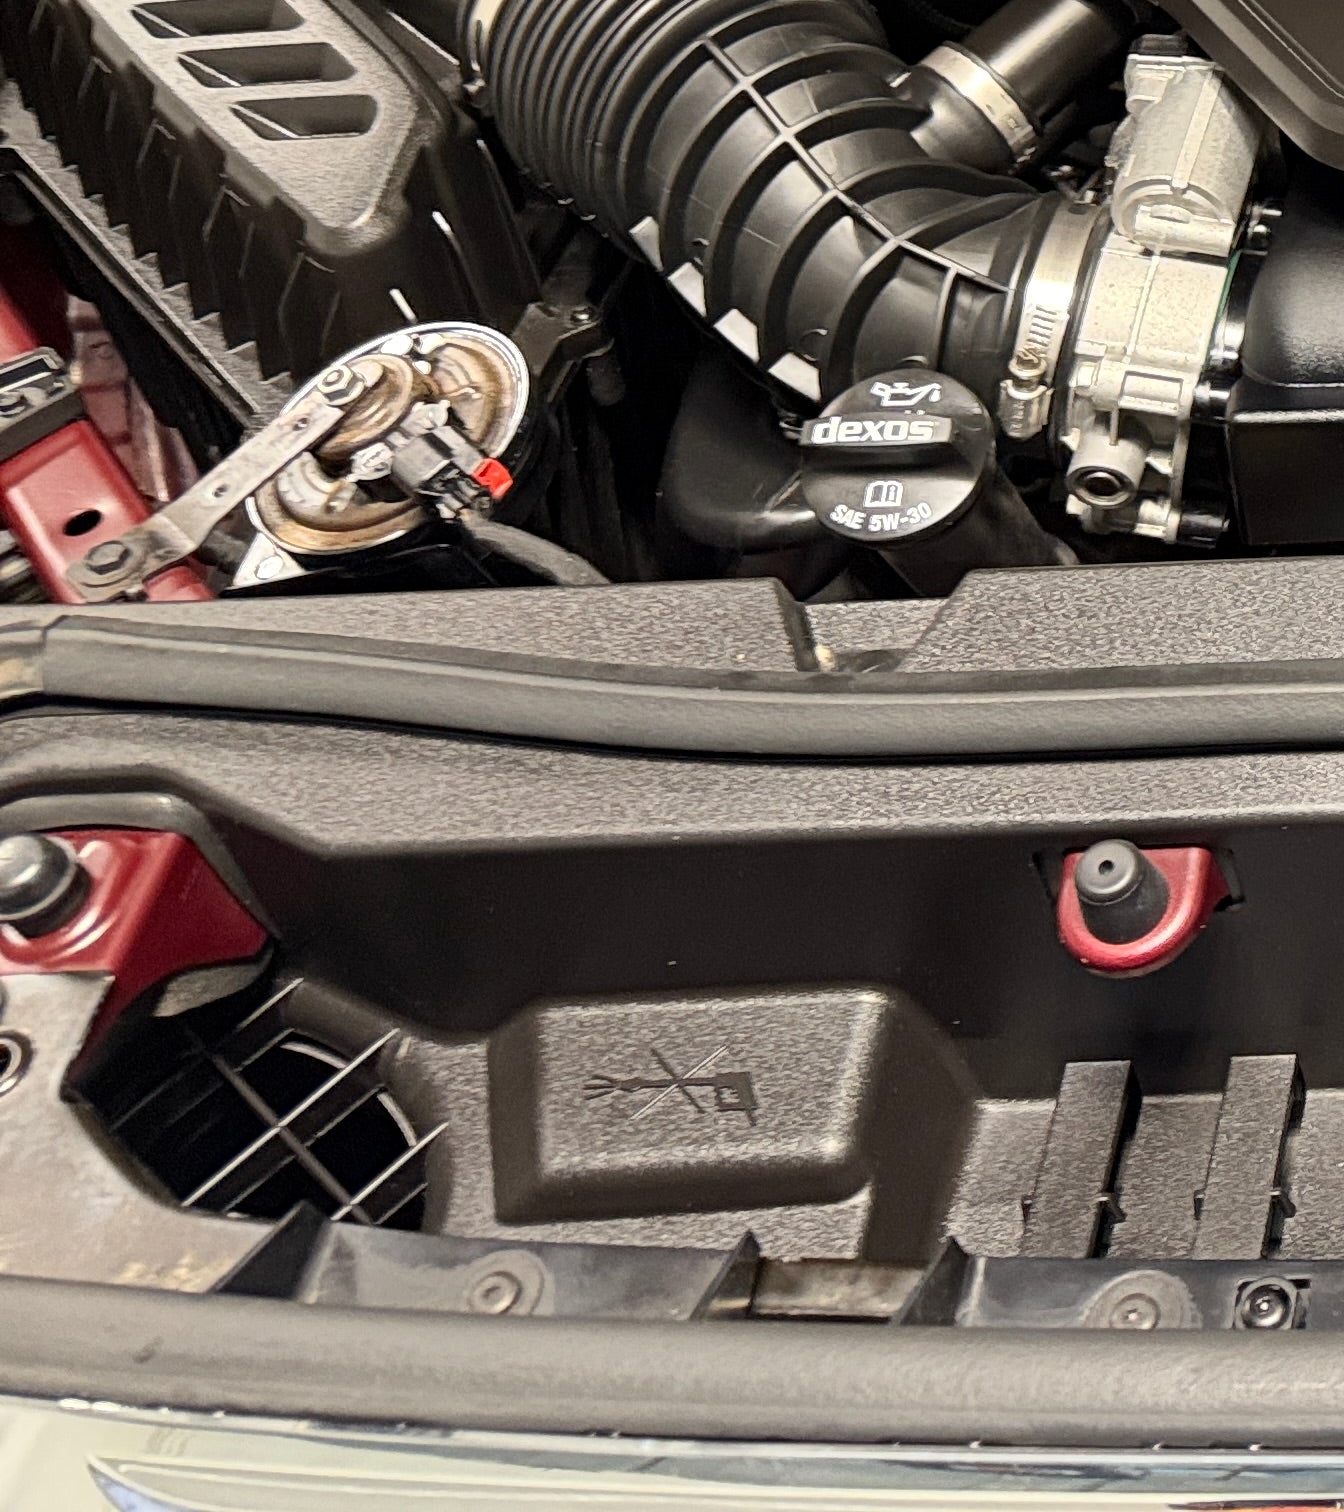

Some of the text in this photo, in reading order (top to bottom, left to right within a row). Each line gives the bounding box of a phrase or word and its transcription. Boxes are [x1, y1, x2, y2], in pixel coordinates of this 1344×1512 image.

[811, 416, 935, 444] dexos
[829, 502, 932, 531] SAE 5W-30
